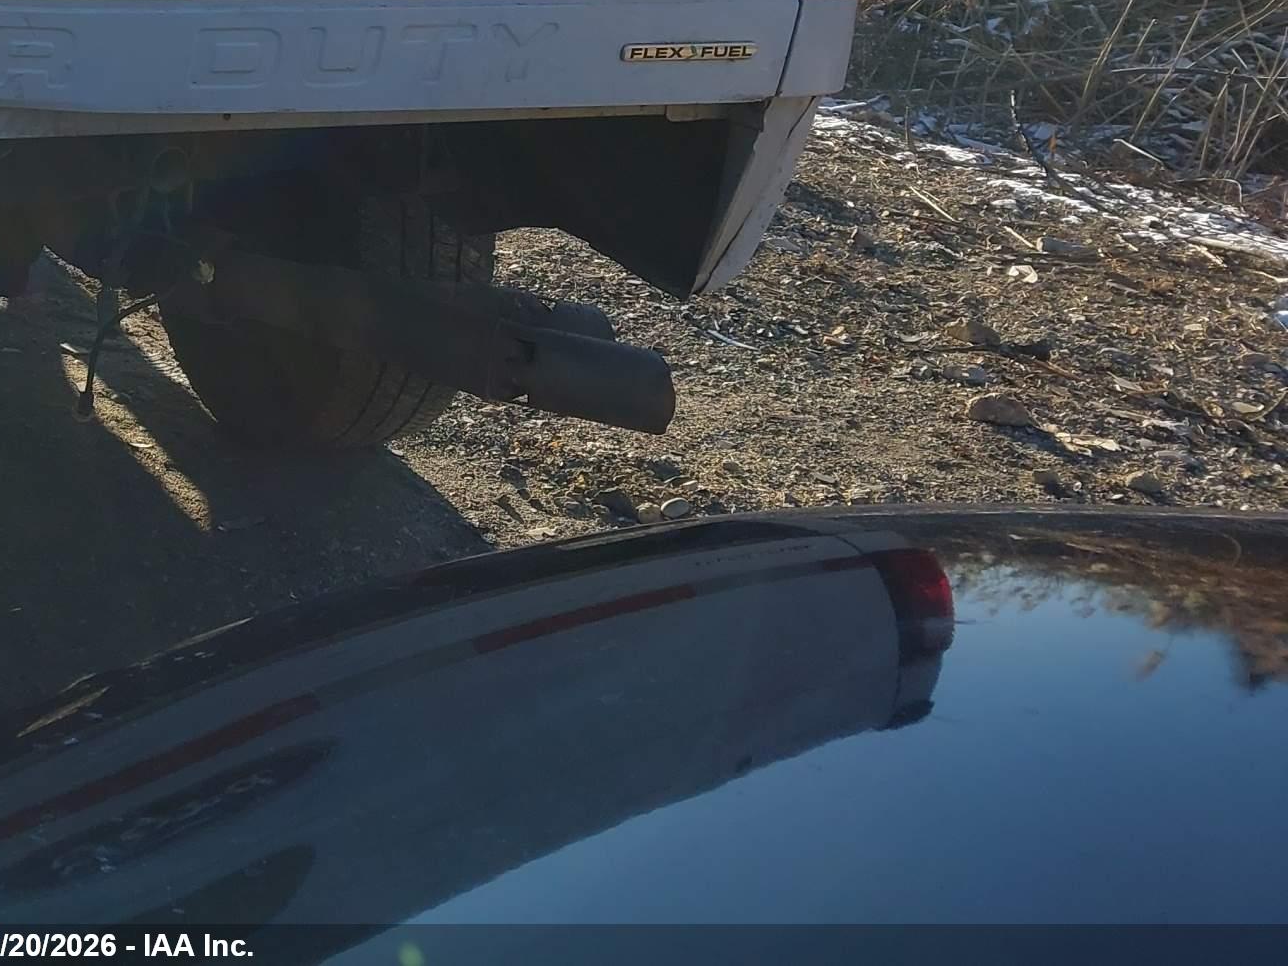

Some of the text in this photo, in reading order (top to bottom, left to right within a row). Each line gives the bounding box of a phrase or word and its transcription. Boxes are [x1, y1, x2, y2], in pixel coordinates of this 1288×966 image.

[188, 21, 562, 90] DUTY
[630, 45, 753, 59] FLEX FUEL
